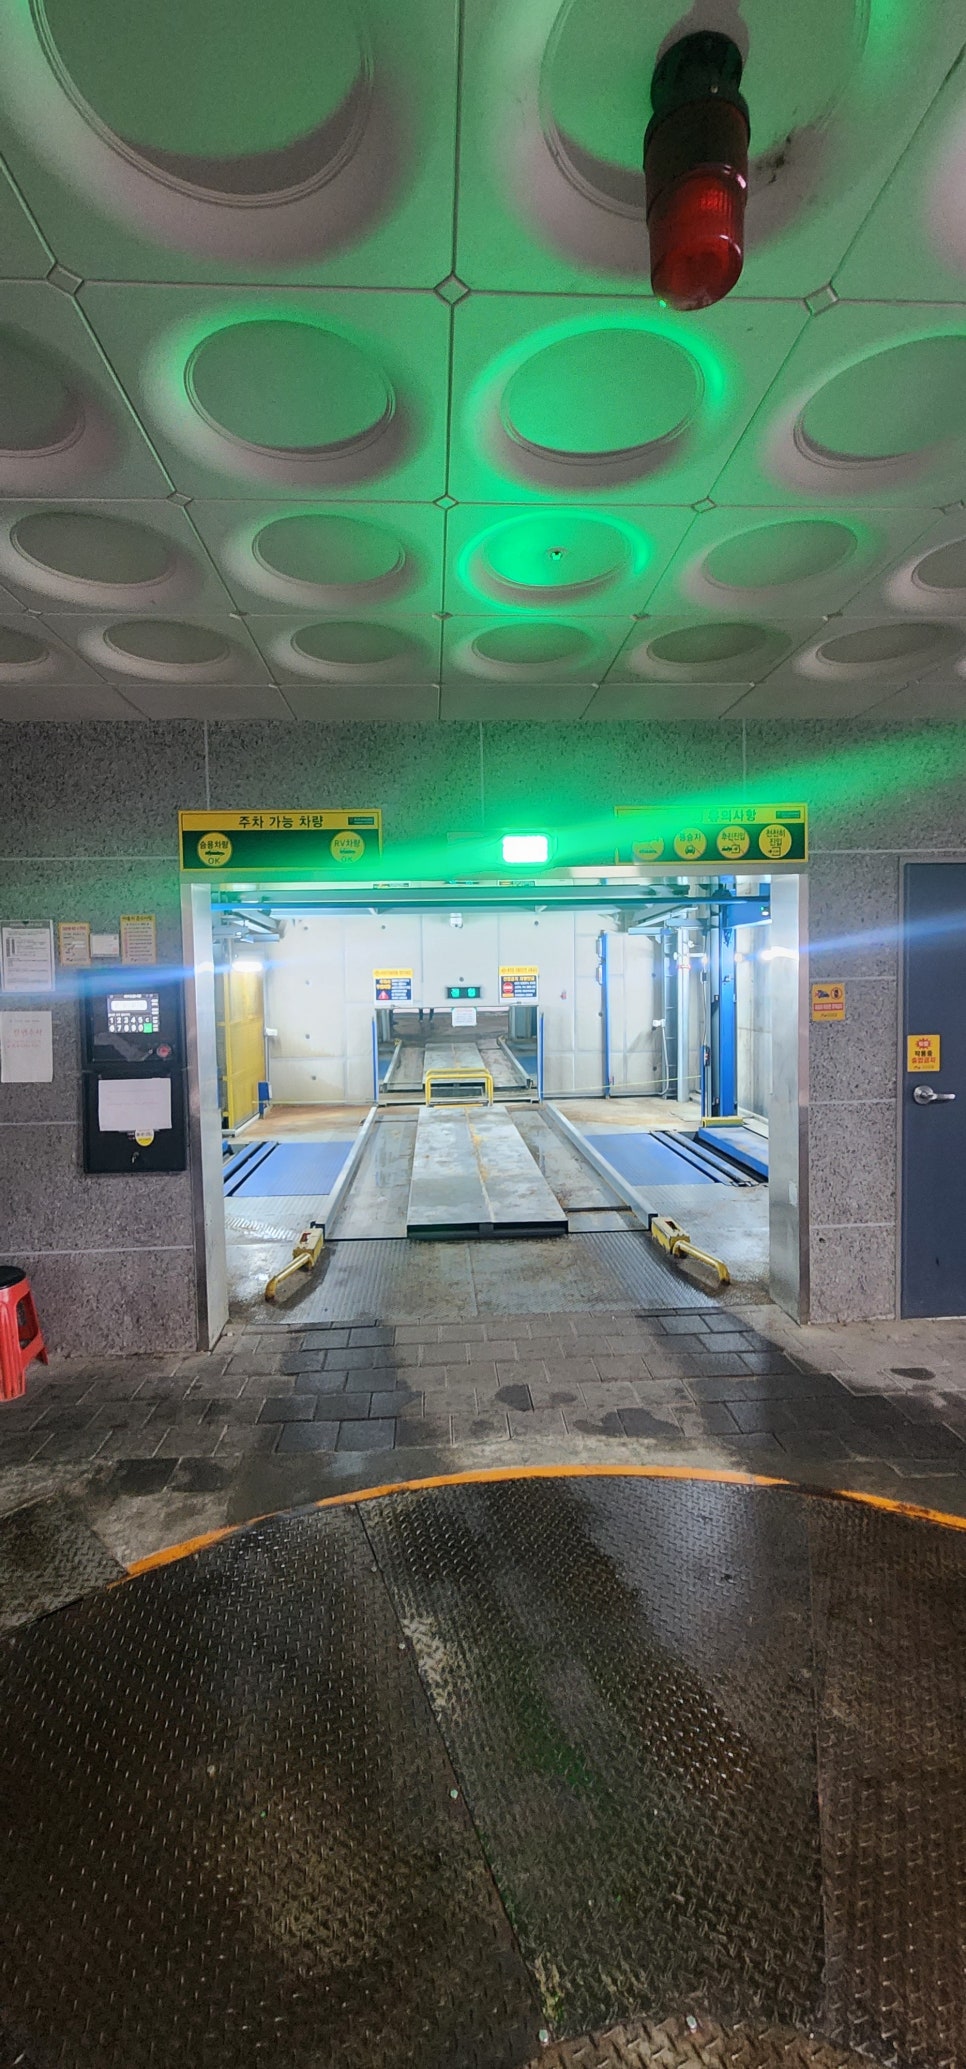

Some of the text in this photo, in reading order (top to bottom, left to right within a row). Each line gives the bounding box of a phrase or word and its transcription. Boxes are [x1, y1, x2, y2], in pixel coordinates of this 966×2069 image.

[238, 815, 323, 828] 주차 가능 차량
[766, 829, 786, 838] 천천히
[199, 840, 229, 849] 승용차량
[334, 839, 361, 848] RV차량
[769, 838, 783, 847] 진입
[208, 857, 221, 865] OK
